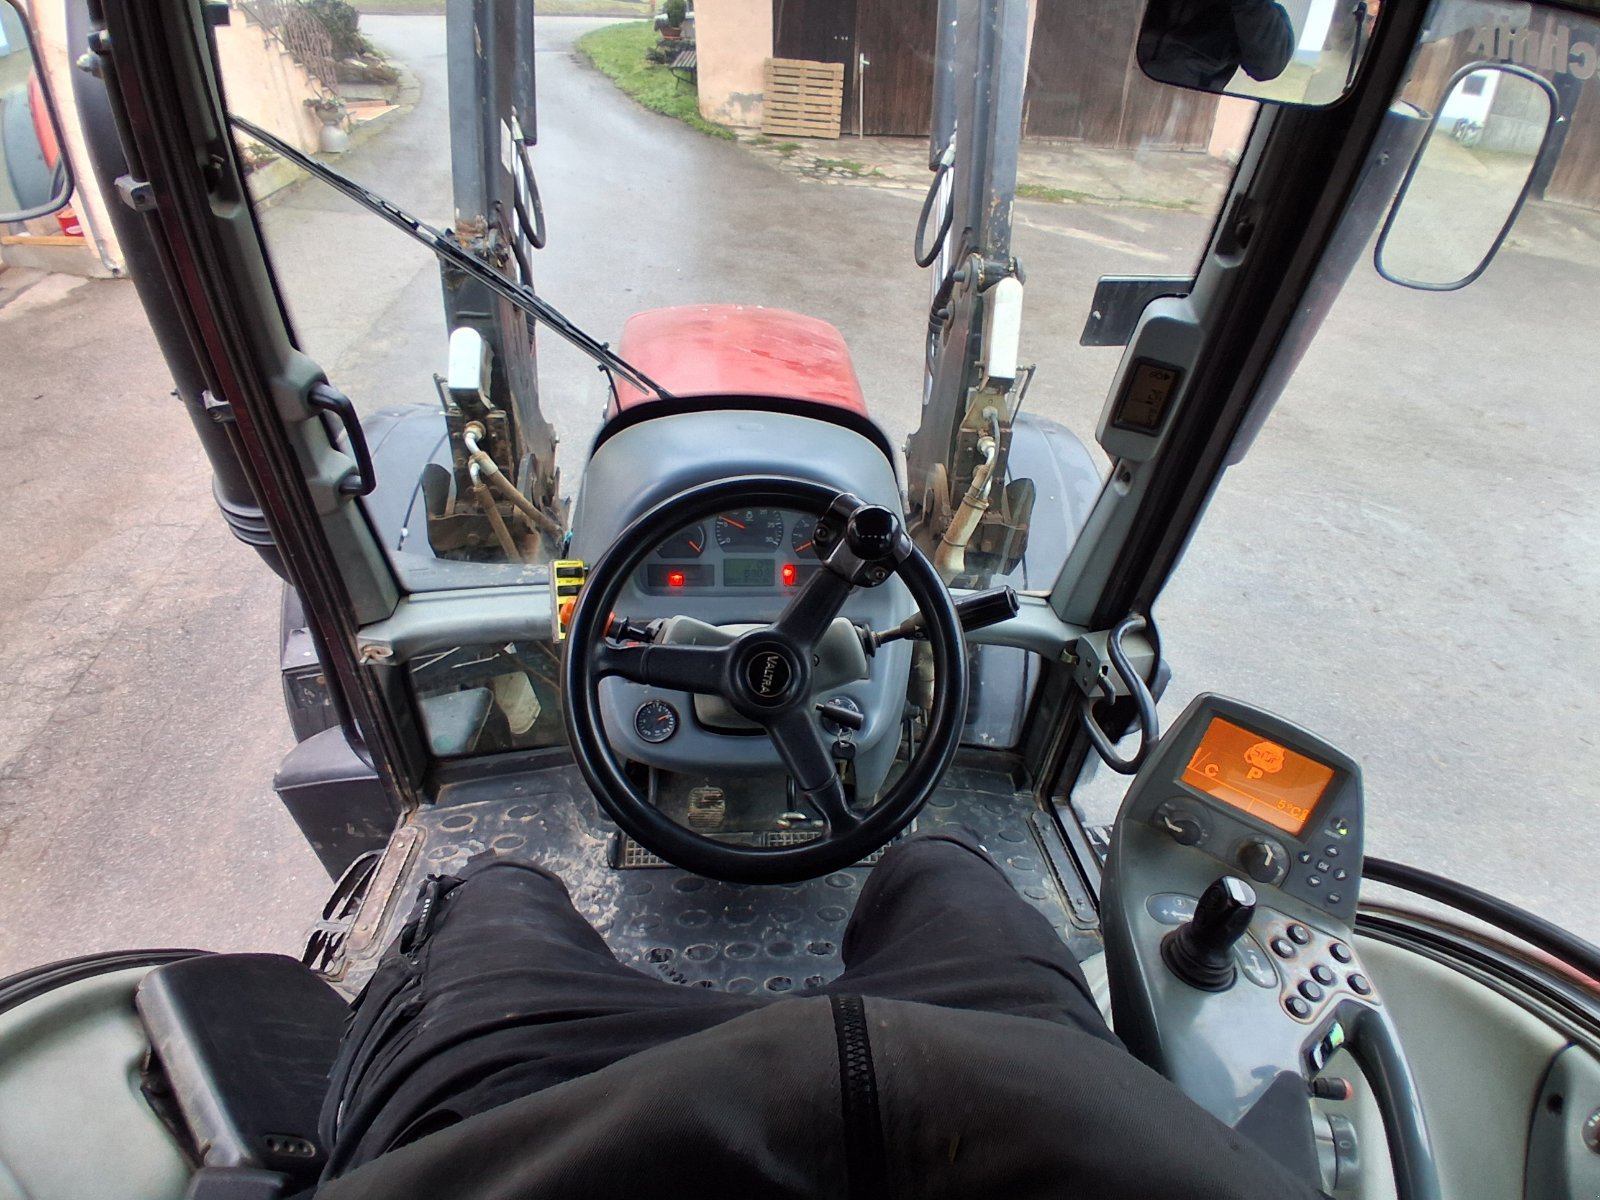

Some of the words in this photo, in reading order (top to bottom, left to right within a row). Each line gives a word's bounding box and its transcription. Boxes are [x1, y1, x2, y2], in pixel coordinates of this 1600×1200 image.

[760, 656, 779, 693] VALTRA
[1246, 766, 1264, 779] P
[1318, 861, 1330, 872] OK
